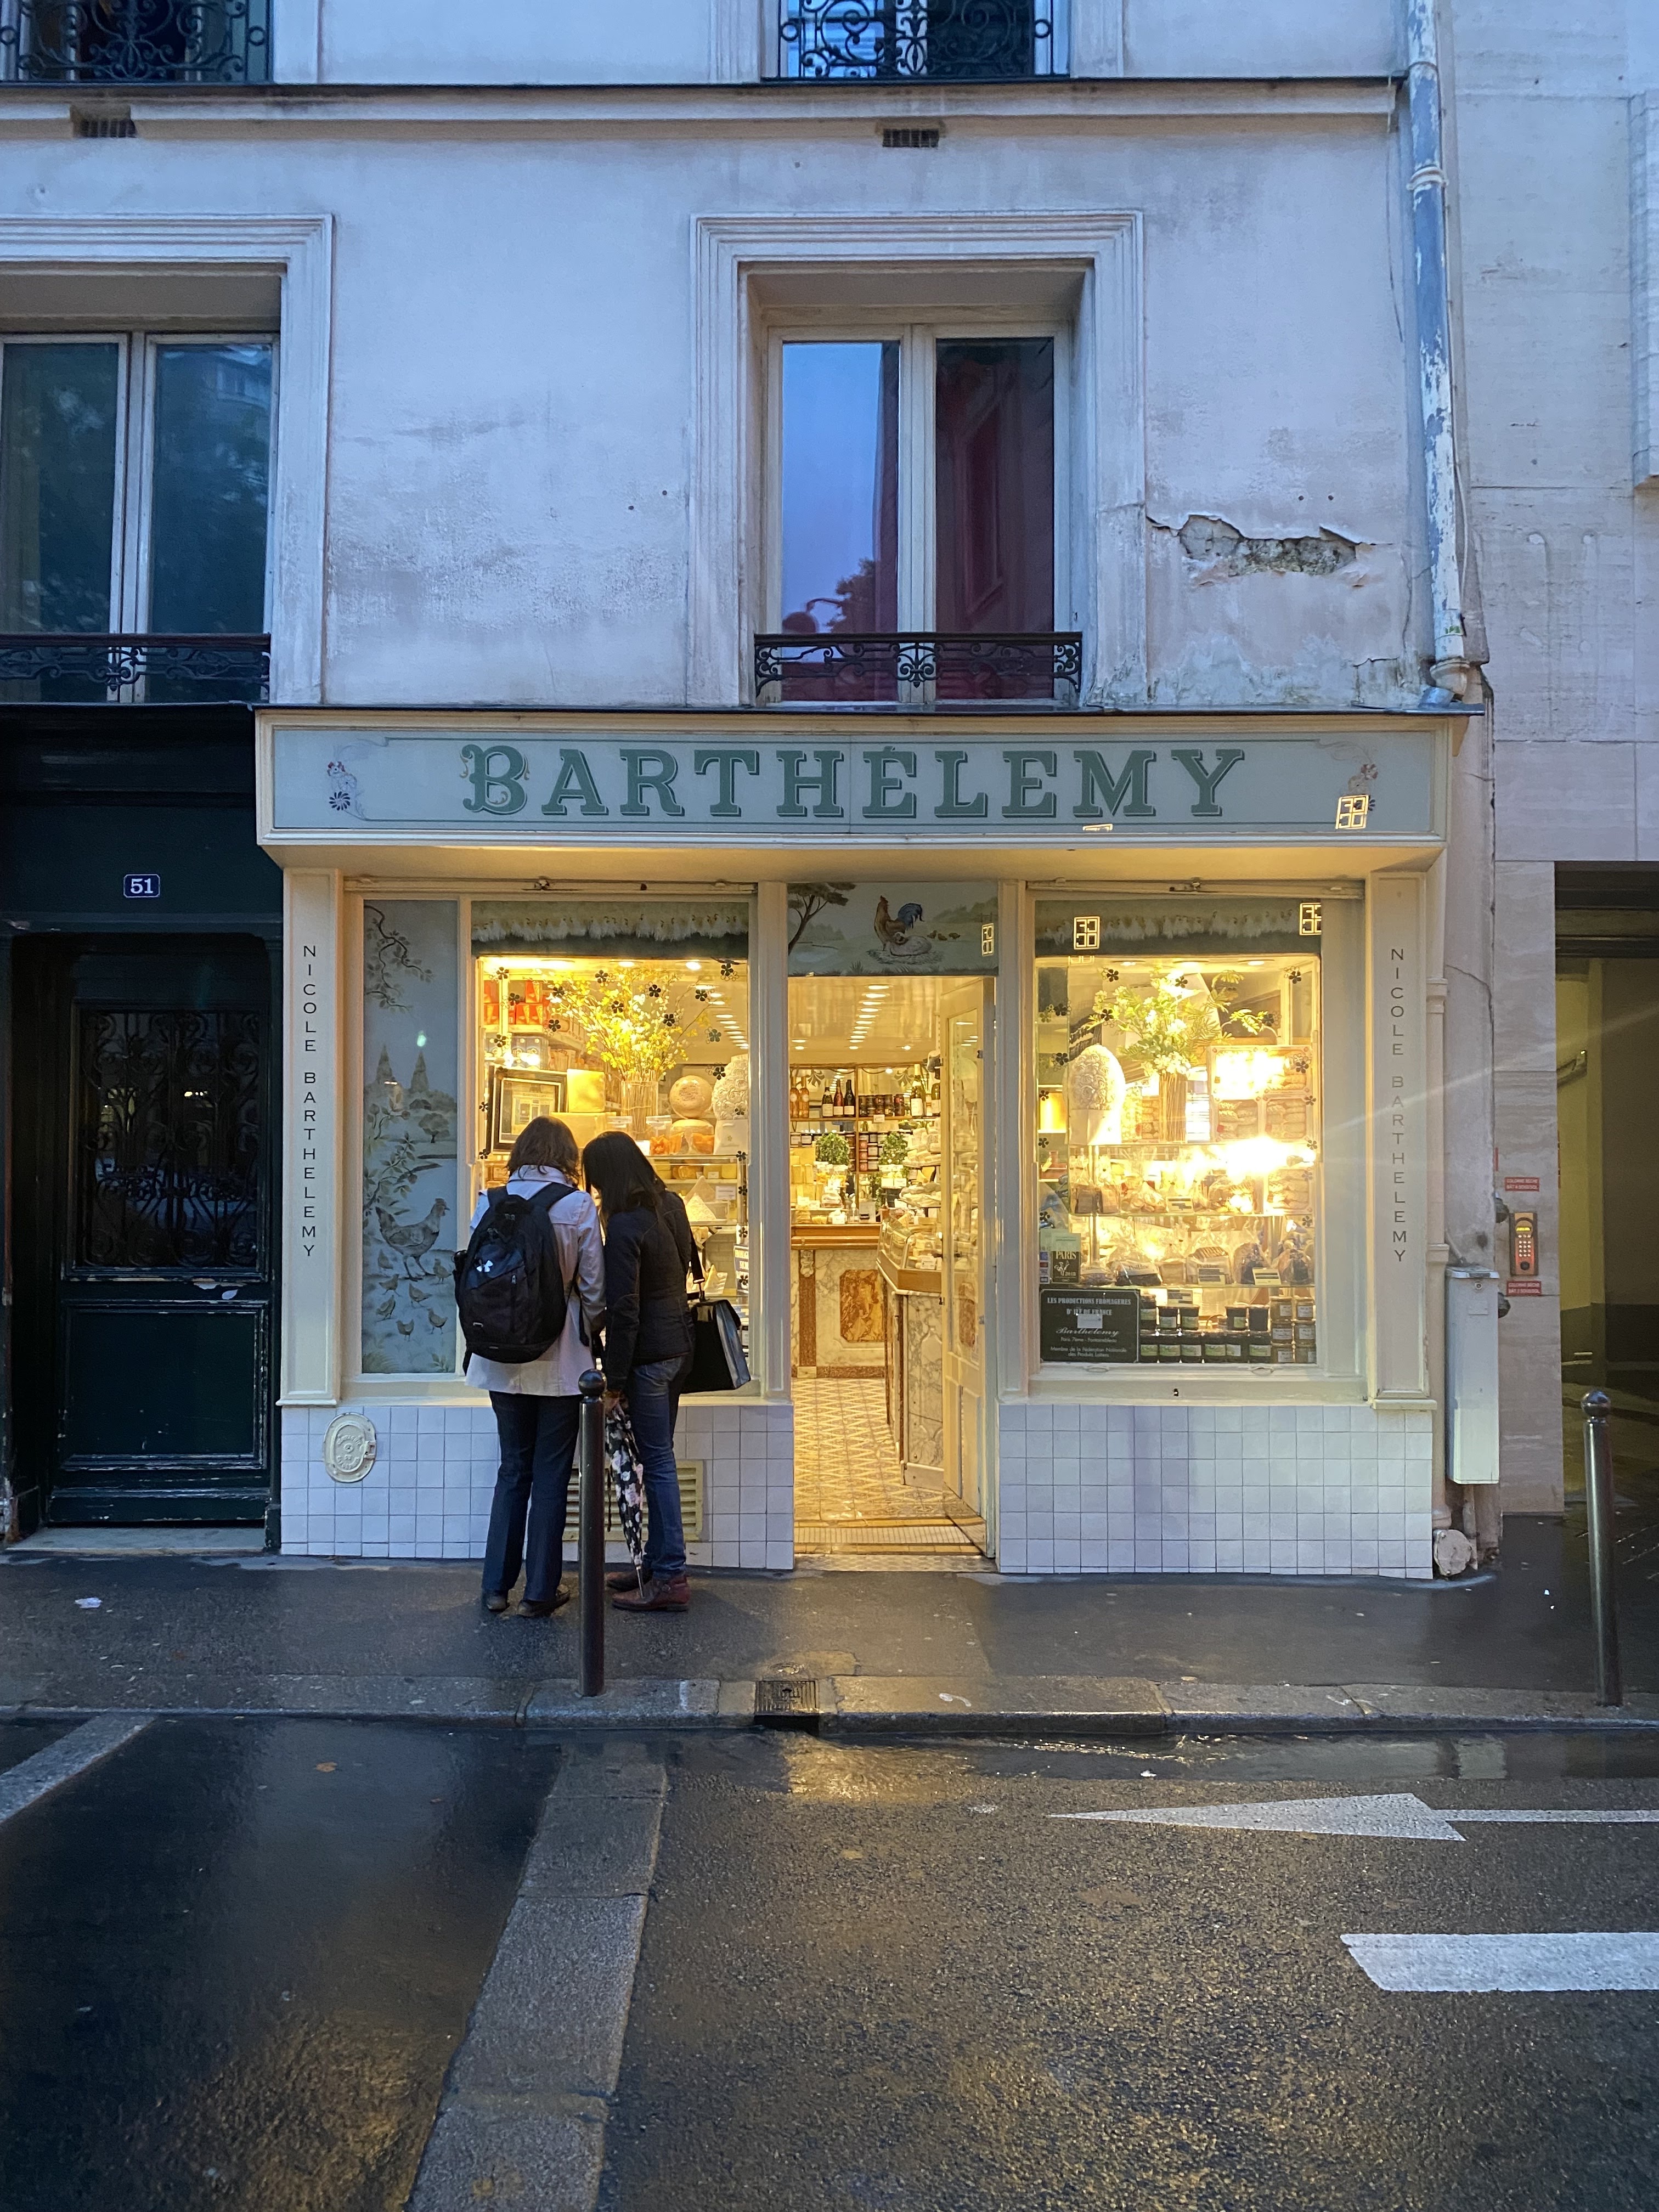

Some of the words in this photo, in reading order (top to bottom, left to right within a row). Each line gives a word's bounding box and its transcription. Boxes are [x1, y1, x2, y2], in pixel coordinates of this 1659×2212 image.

[460, 744, 1245, 818] BARTHÉLEMY
[131, 878, 154, 894] 51
[302, 945, 316, 1052] NICOLE
[1390, 948, 1404, 1056] NICOLE
[302, 1071, 317, 1257] BARTHELEMY
[1391, 1076, 1407, 1262] BARTHELEMY
[1056, 1251, 1076, 1259] PARIS
